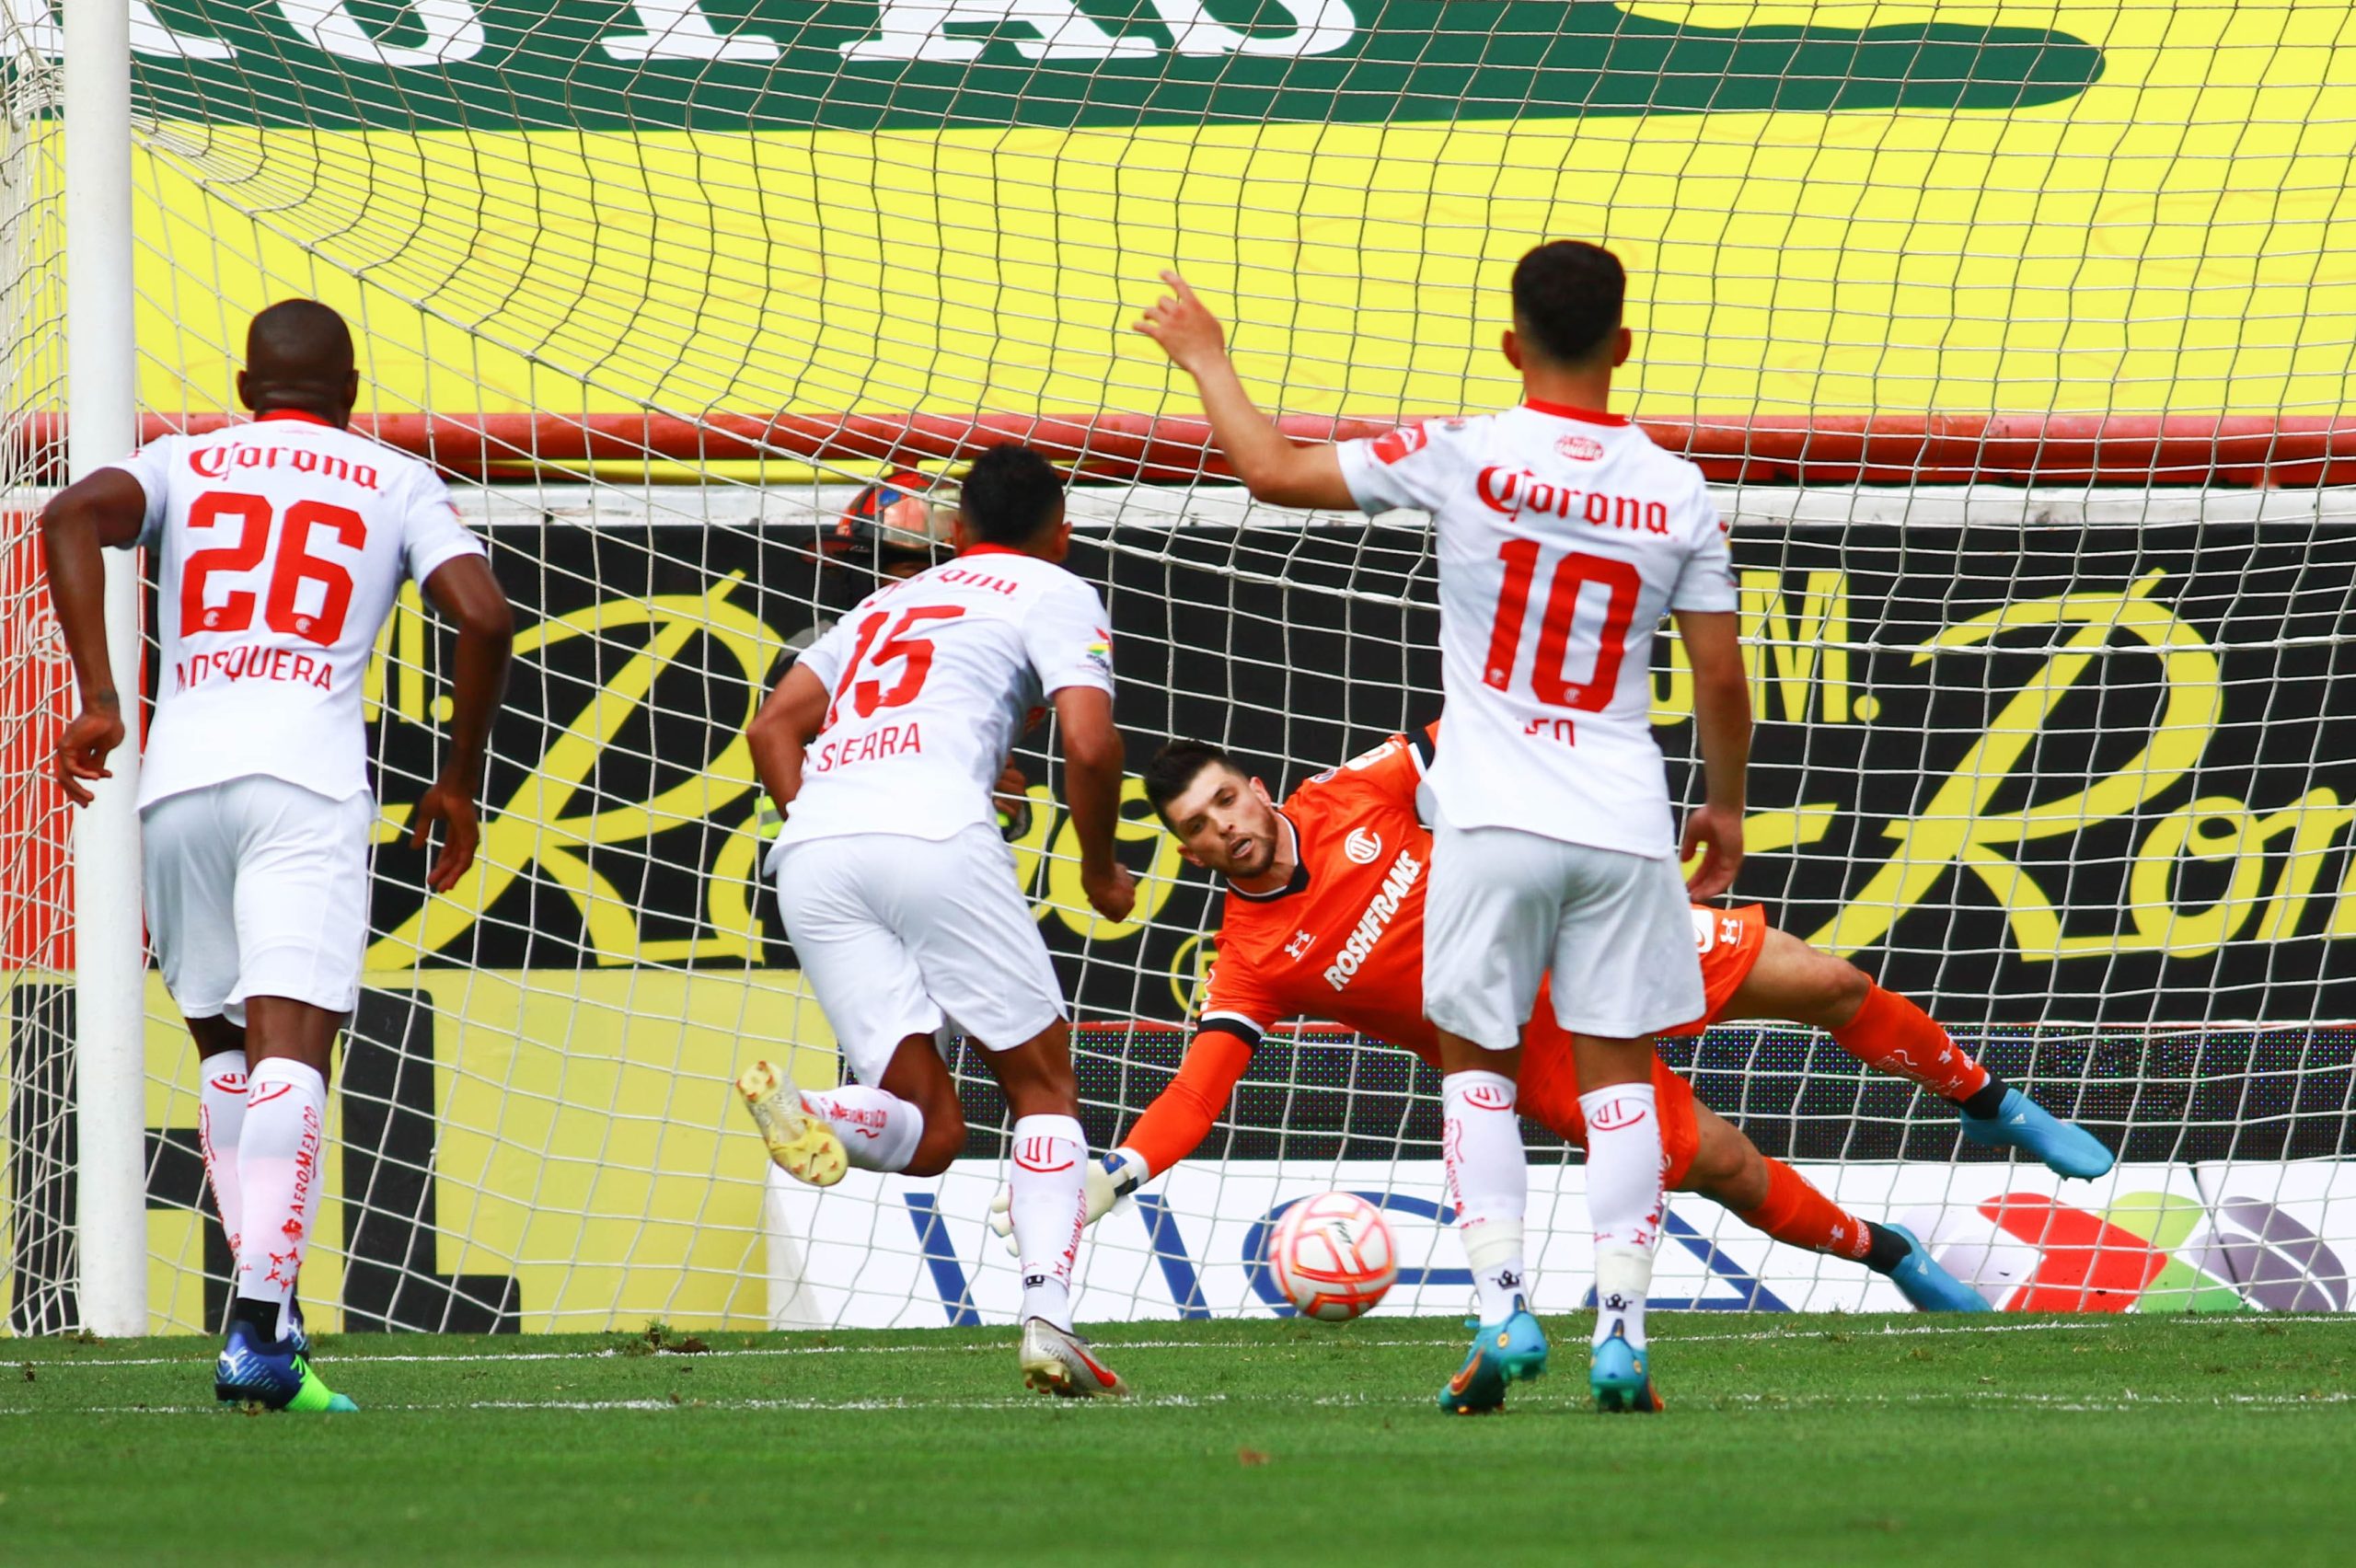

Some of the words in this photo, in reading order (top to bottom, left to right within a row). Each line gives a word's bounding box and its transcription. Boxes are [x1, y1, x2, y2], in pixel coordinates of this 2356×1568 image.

[189, 443, 379, 490] Corona
[1476, 466, 1670, 535] Corona
[179, 491, 367, 648] 26
[1483, 538, 1642, 713] 10
[819, 605, 965, 734] 15
[816, 722, 922, 772] SIERRA
[1323, 849, 1421, 992] ROSHFRANS
